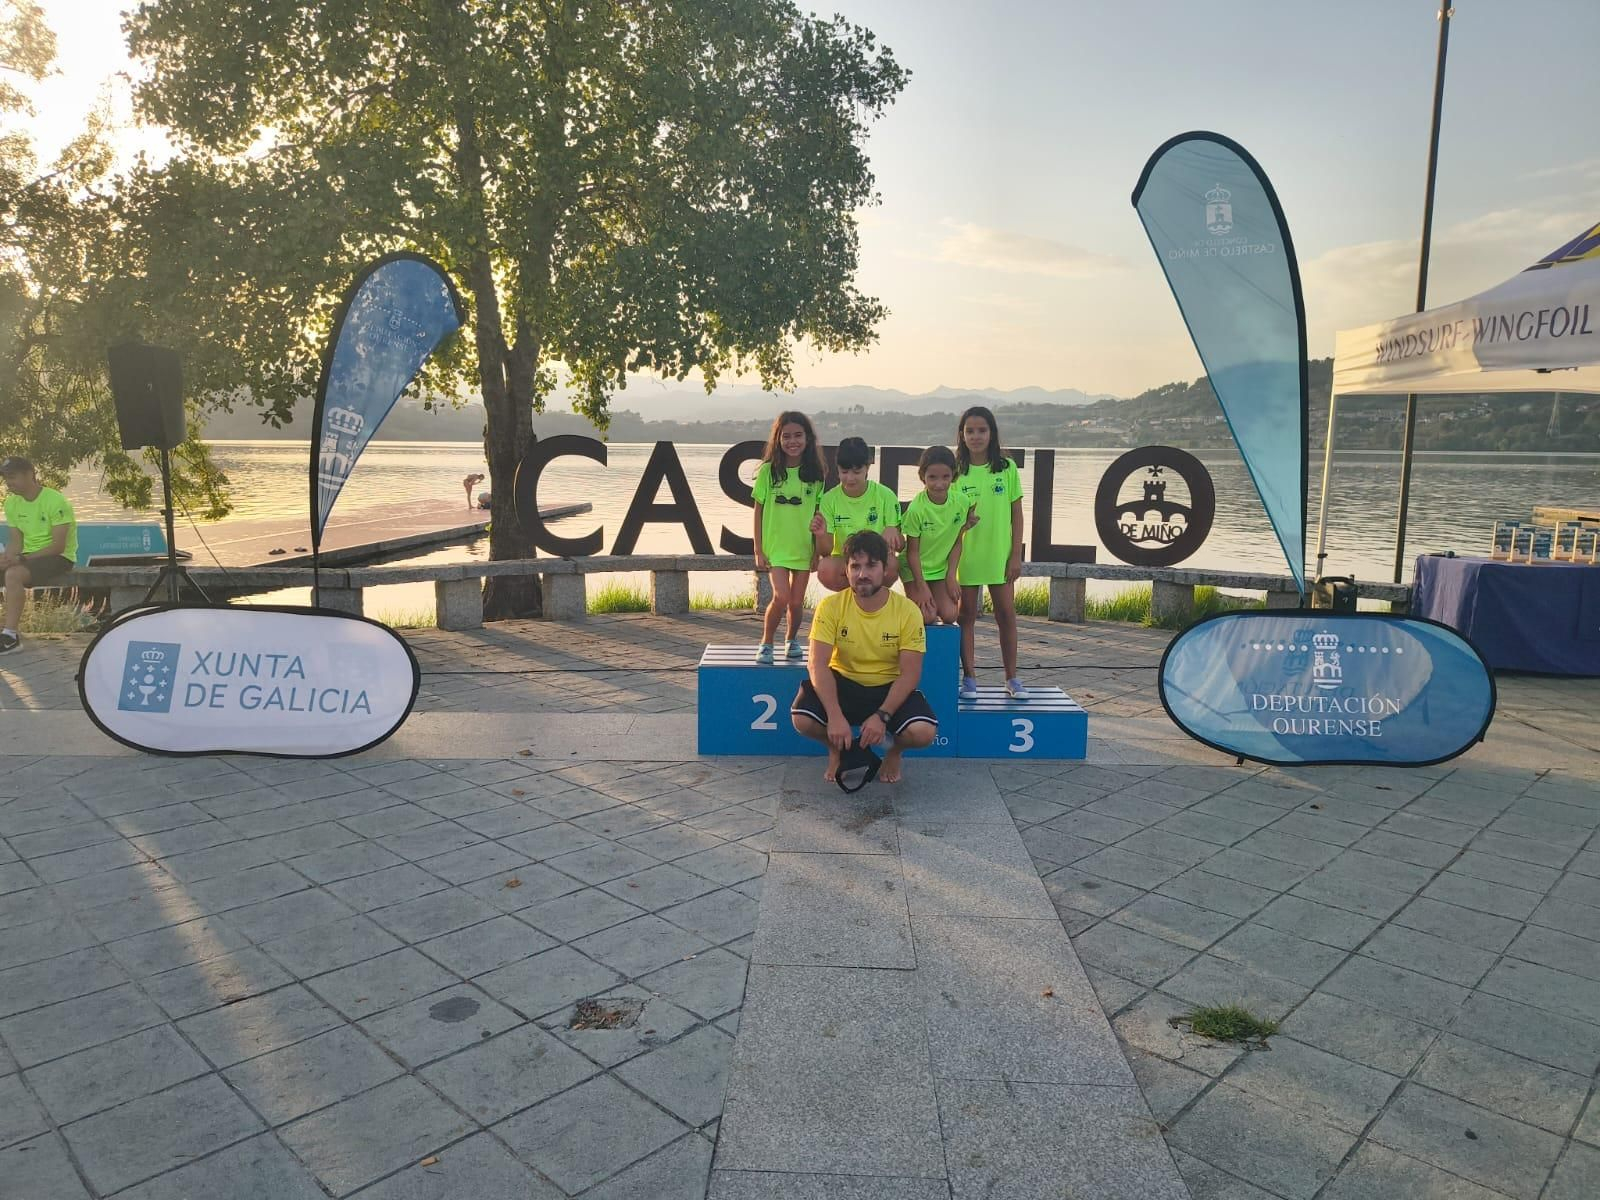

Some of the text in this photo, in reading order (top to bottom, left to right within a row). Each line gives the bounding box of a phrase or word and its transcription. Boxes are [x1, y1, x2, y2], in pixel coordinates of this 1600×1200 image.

[1376, 304, 1593, 362] WINDSURF-WINGFOIL
[1120, 522, 1184, 541] DE MIÑO
[190, 650, 306, 680] XUNTA
[184, 682, 372, 715] DE GALICIA
[750, 693, 778, 730] 2
[1252, 692, 1401, 716] DEPUTACIÓN
[1008, 718, 1035, 753] 3
[1273, 717, 1383, 737] OURENSE
